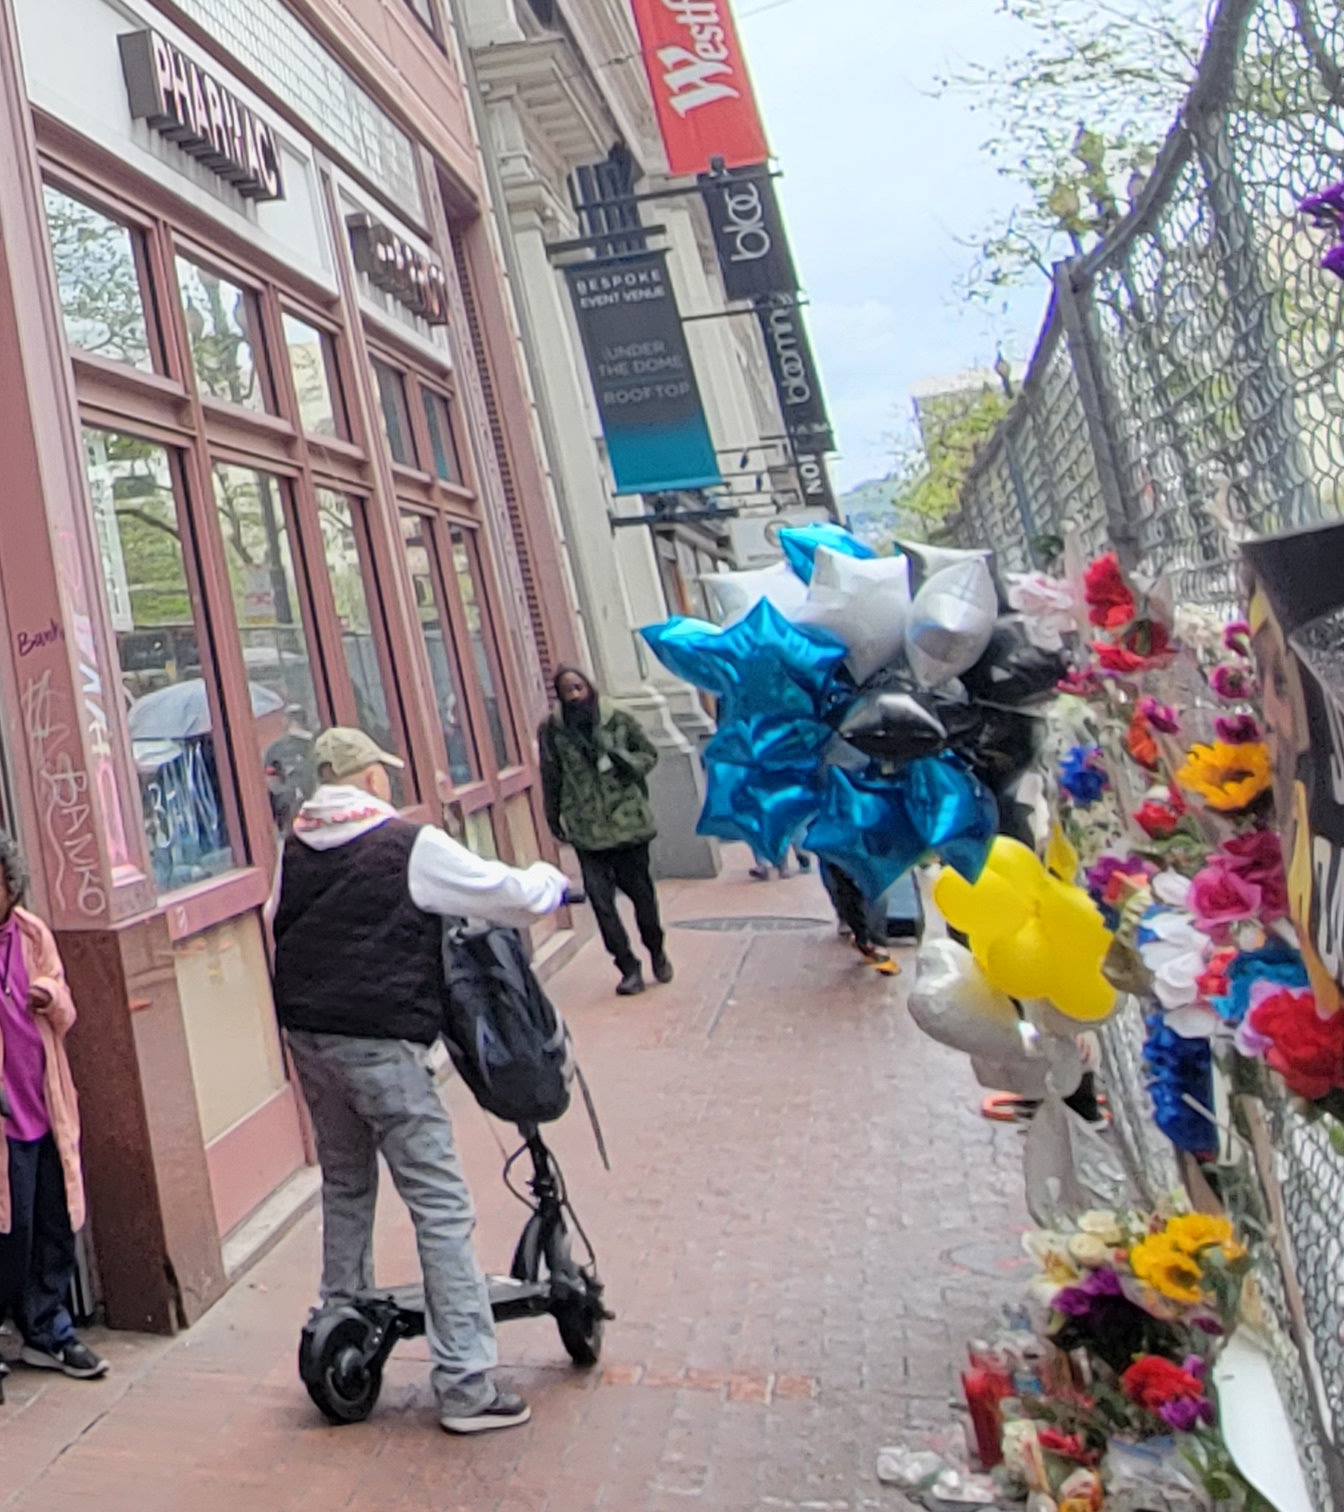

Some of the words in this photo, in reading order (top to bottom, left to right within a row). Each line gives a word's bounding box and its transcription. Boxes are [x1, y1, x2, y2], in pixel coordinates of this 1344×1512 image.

[576, 269, 662, 296] BESPOKE
[580, 291, 620, 309] EVENT
[622, 285, 665, 303] VENUE
